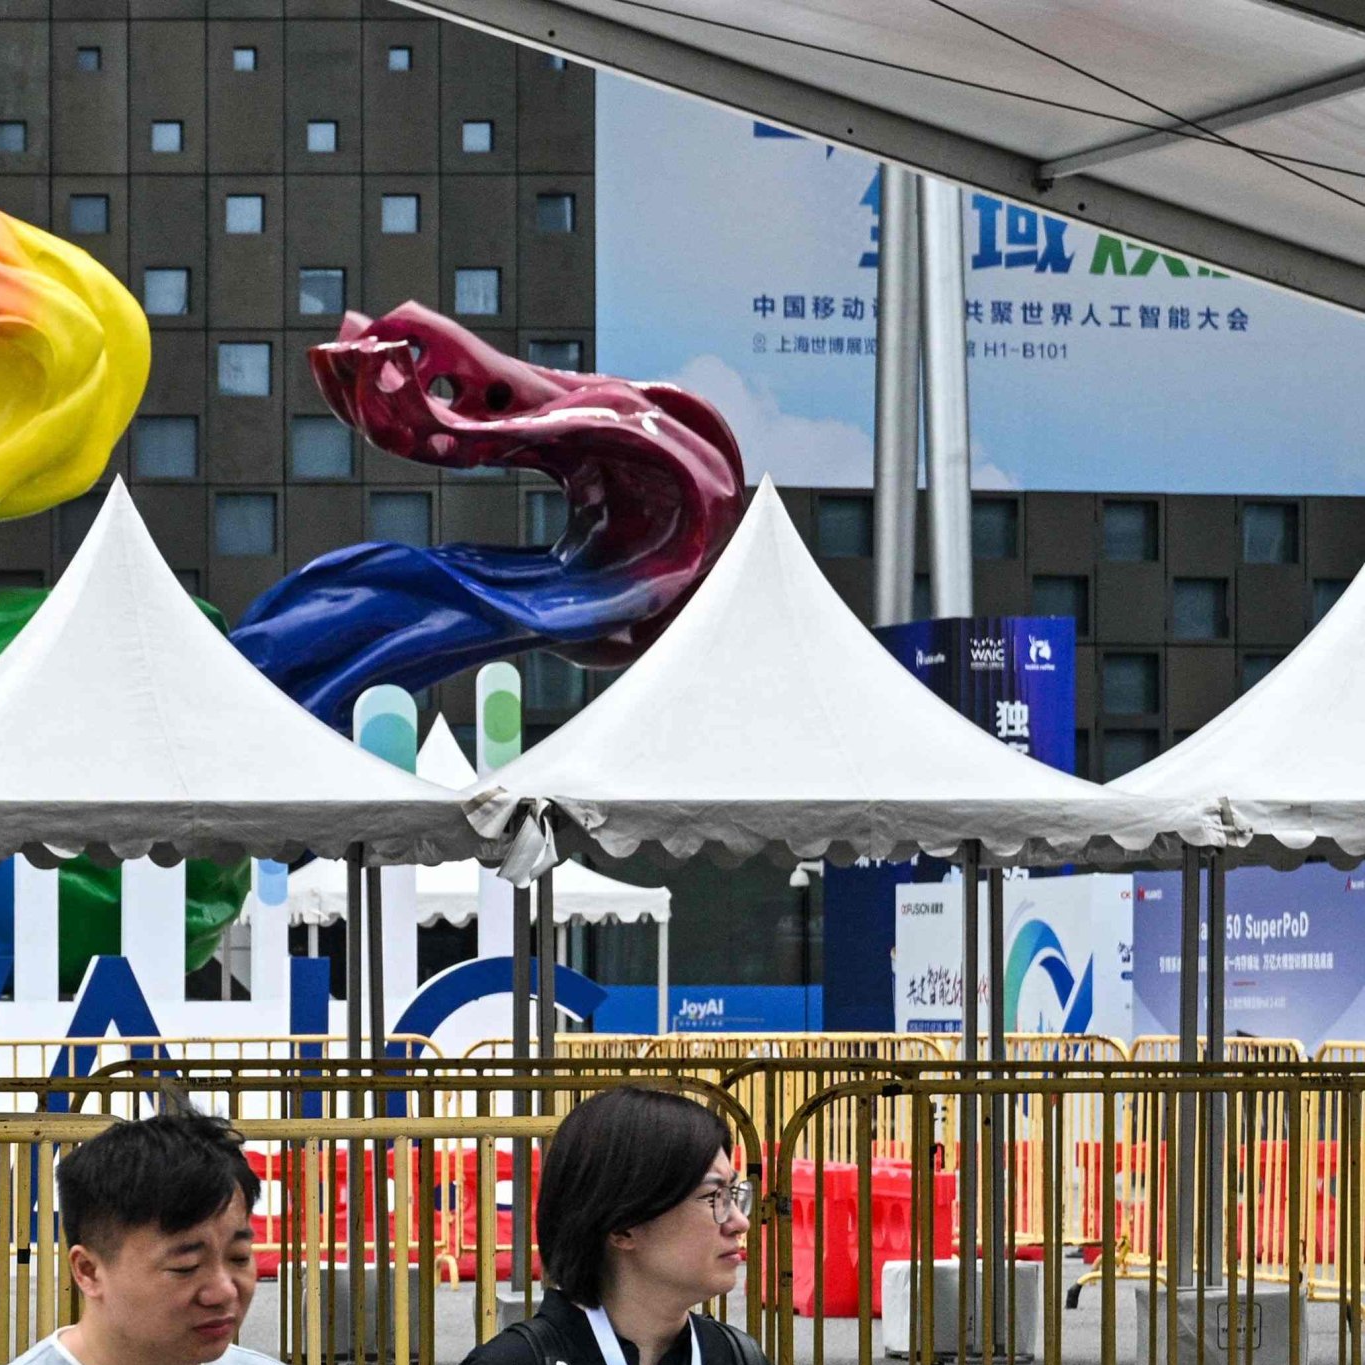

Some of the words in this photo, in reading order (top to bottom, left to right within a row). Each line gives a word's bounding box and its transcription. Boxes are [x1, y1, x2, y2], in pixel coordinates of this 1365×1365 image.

[983, 341, 1068, 359] H1-B101
[970, 648, 1005, 662] WAIC
[1226, 915, 1241, 940] 50
[1245, 911, 1310, 944] SuperPoD
[679, 998, 724, 1019] JoyAI
